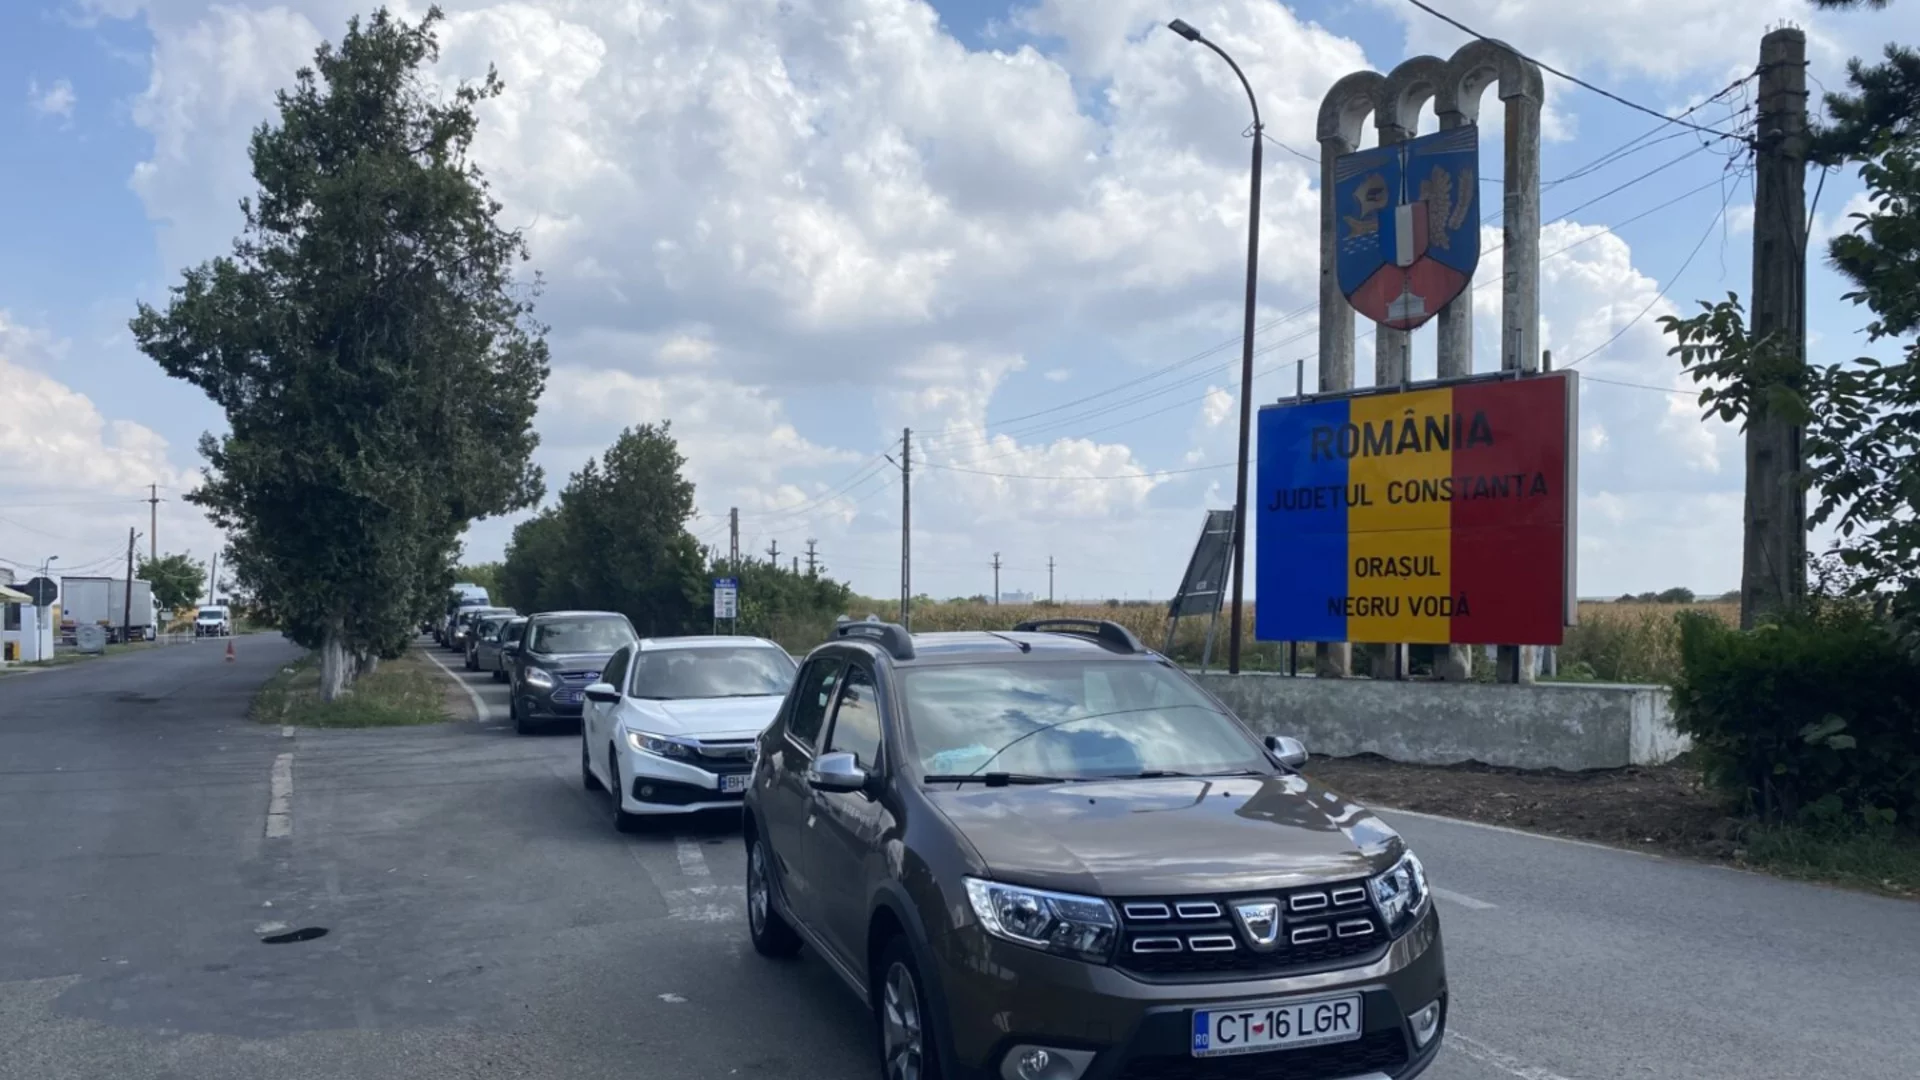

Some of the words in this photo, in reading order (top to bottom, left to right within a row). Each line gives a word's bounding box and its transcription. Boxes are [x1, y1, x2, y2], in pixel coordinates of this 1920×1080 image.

[1312, 409, 1493, 461] ROMÂNIA
[1327, 596, 1400, 617] NEGRU
[1408, 591, 1470, 617] VODĂ
[728, 776, 745, 788] BH
[1217, 1013, 1254, 1043] CT
[1265, 1009, 1291, 1040] 16
[1298, 1003, 1351, 1036] LGR
[1195, 1034, 1208, 1046] RO
